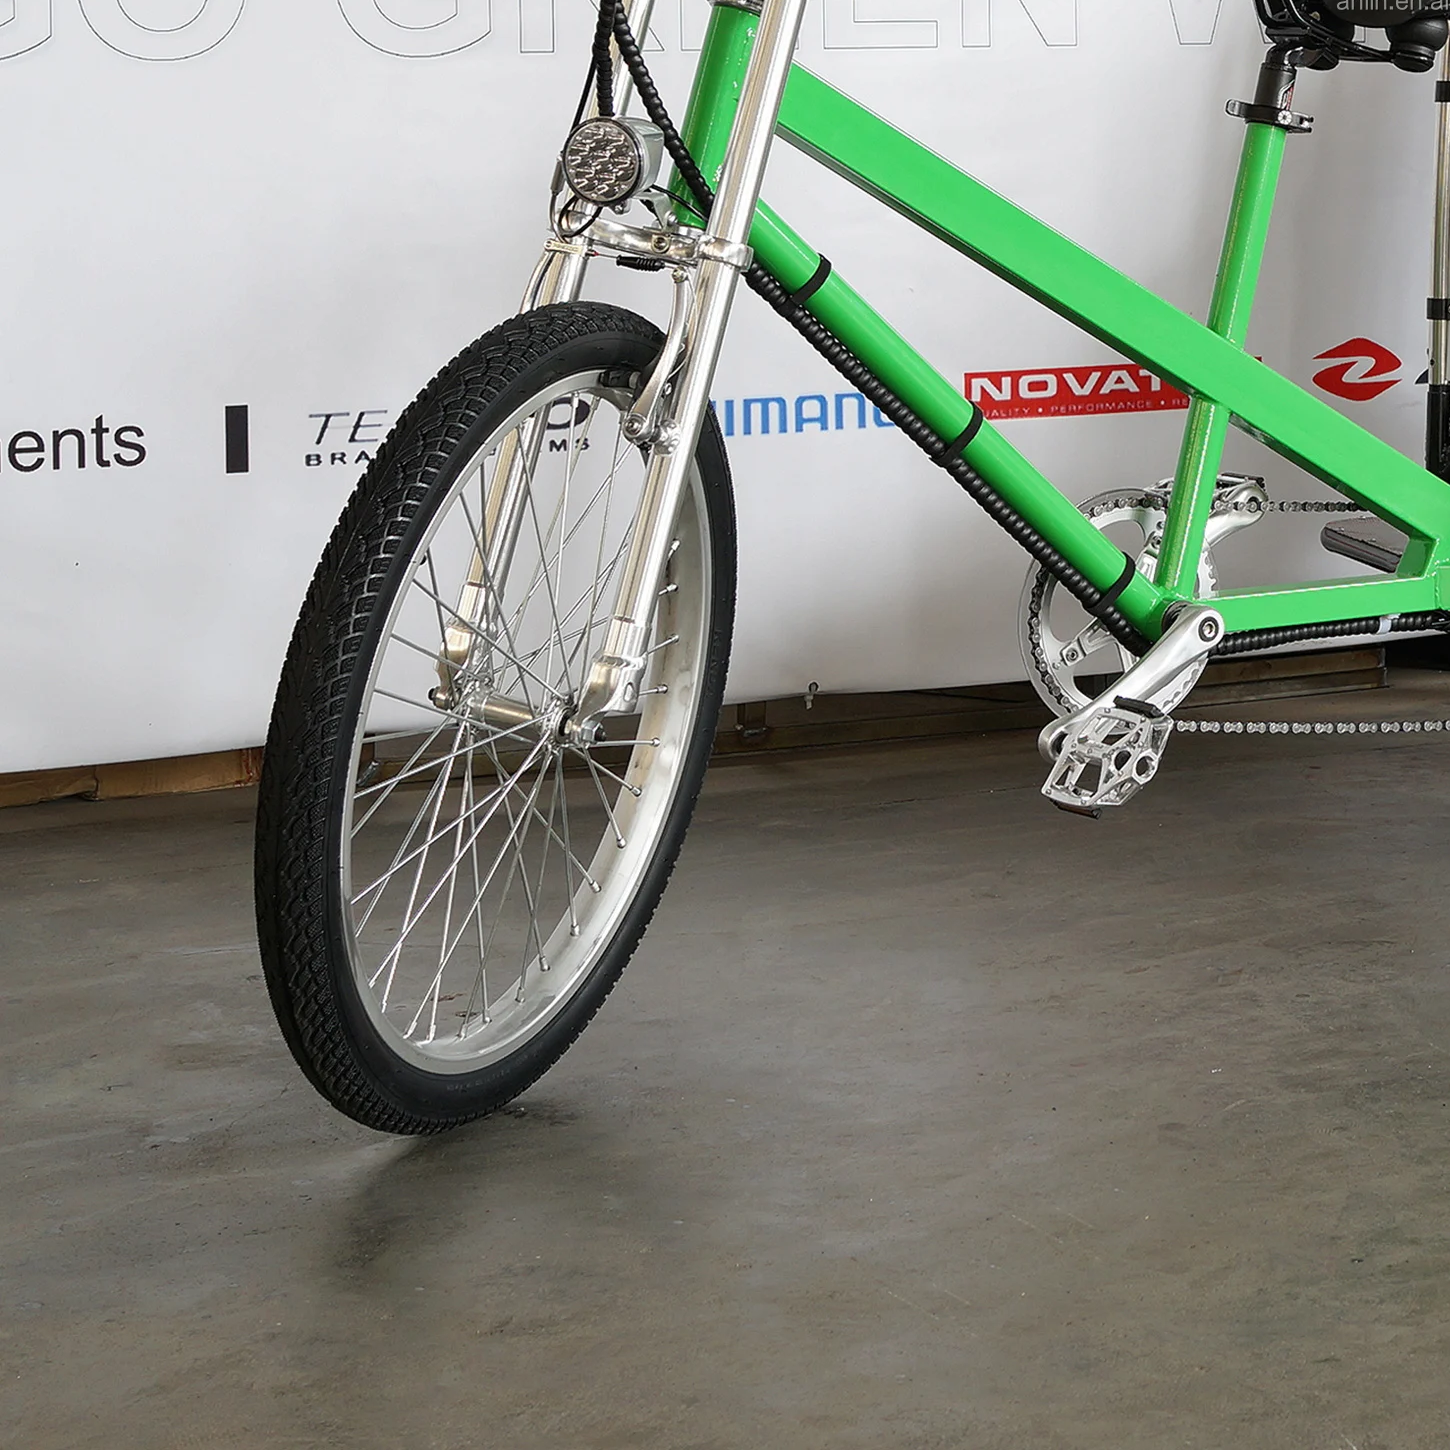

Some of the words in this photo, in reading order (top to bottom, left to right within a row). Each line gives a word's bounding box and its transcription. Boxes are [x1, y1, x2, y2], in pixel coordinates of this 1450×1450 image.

[971, 369, 1163, 402] NOVAT
[701, 393, 896, 437] IMAN
[1050, 400, 1152, 414] PERFORMANCE
[0, 414, 147, 474] ents
